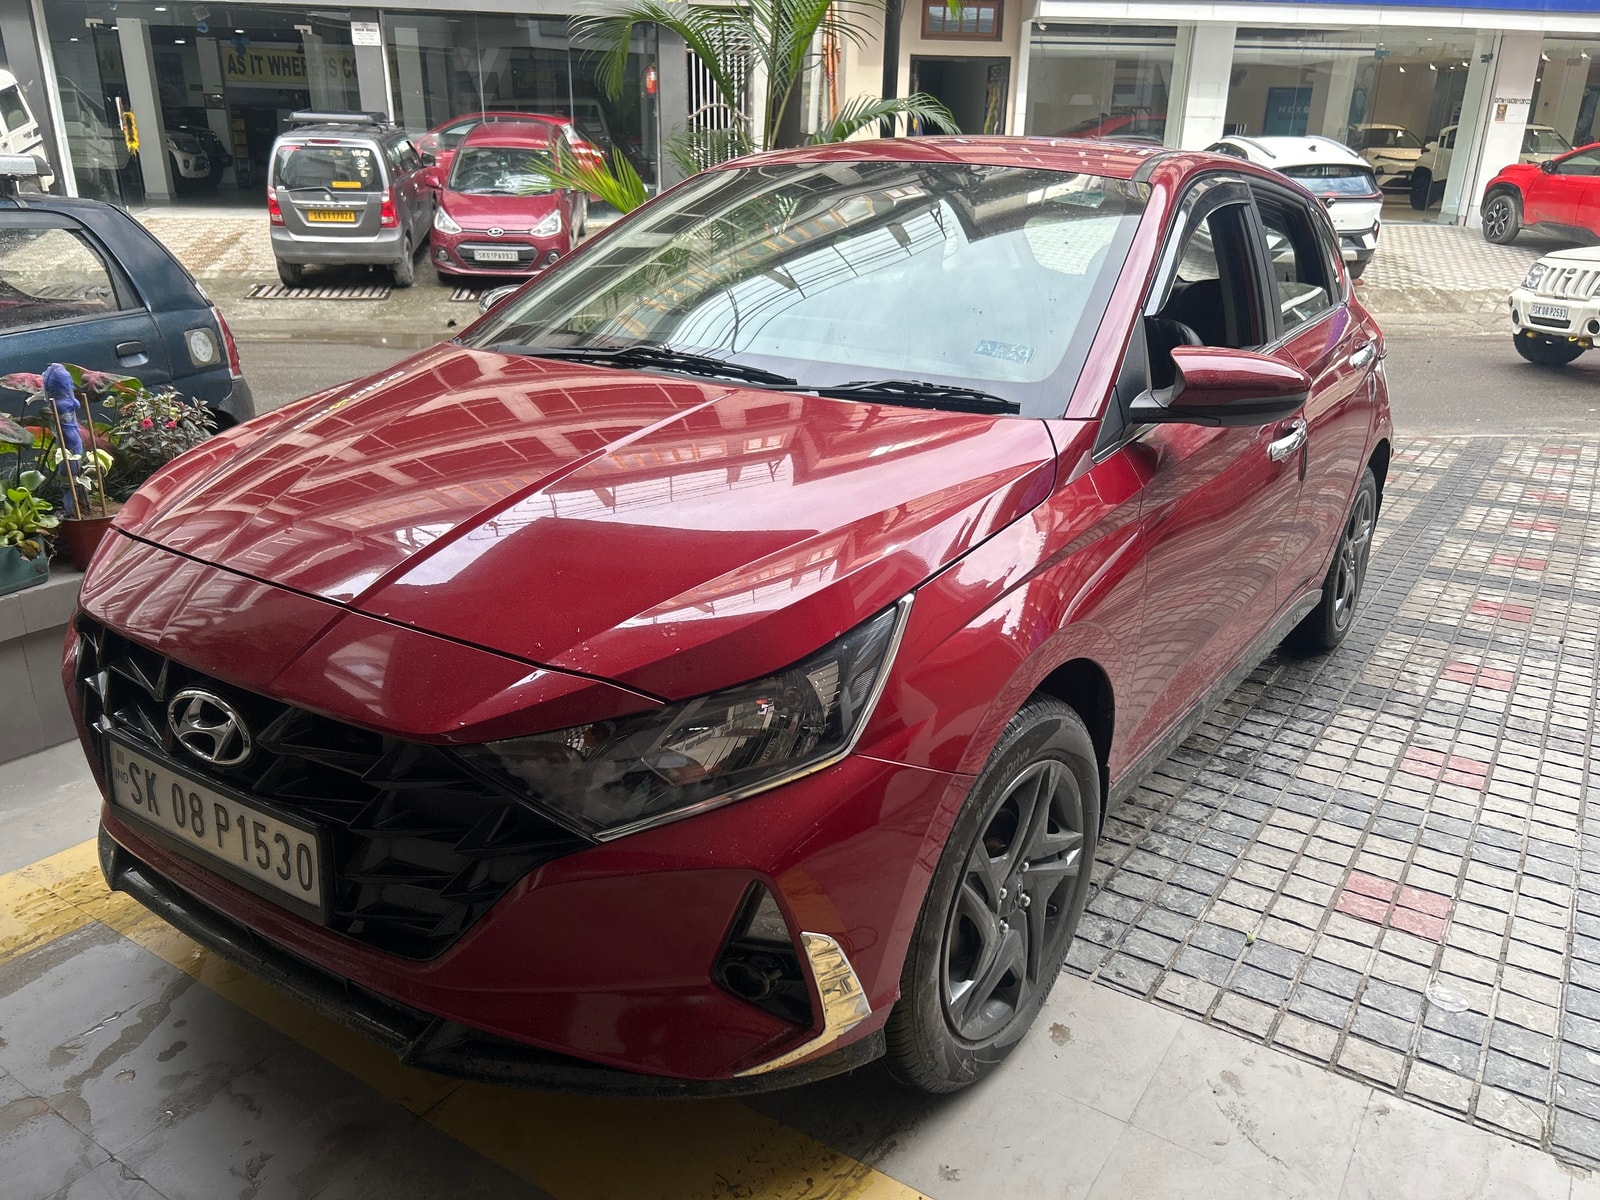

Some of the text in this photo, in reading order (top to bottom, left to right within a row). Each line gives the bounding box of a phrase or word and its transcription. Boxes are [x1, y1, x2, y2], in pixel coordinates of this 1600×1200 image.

[228, 54, 246, 75] AS
[251, 55, 264, 75] IT
[267, 56, 315, 78] WHER
[114, 767, 129, 785] IND
[128, 761, 313, 891] SK 08 P1530
